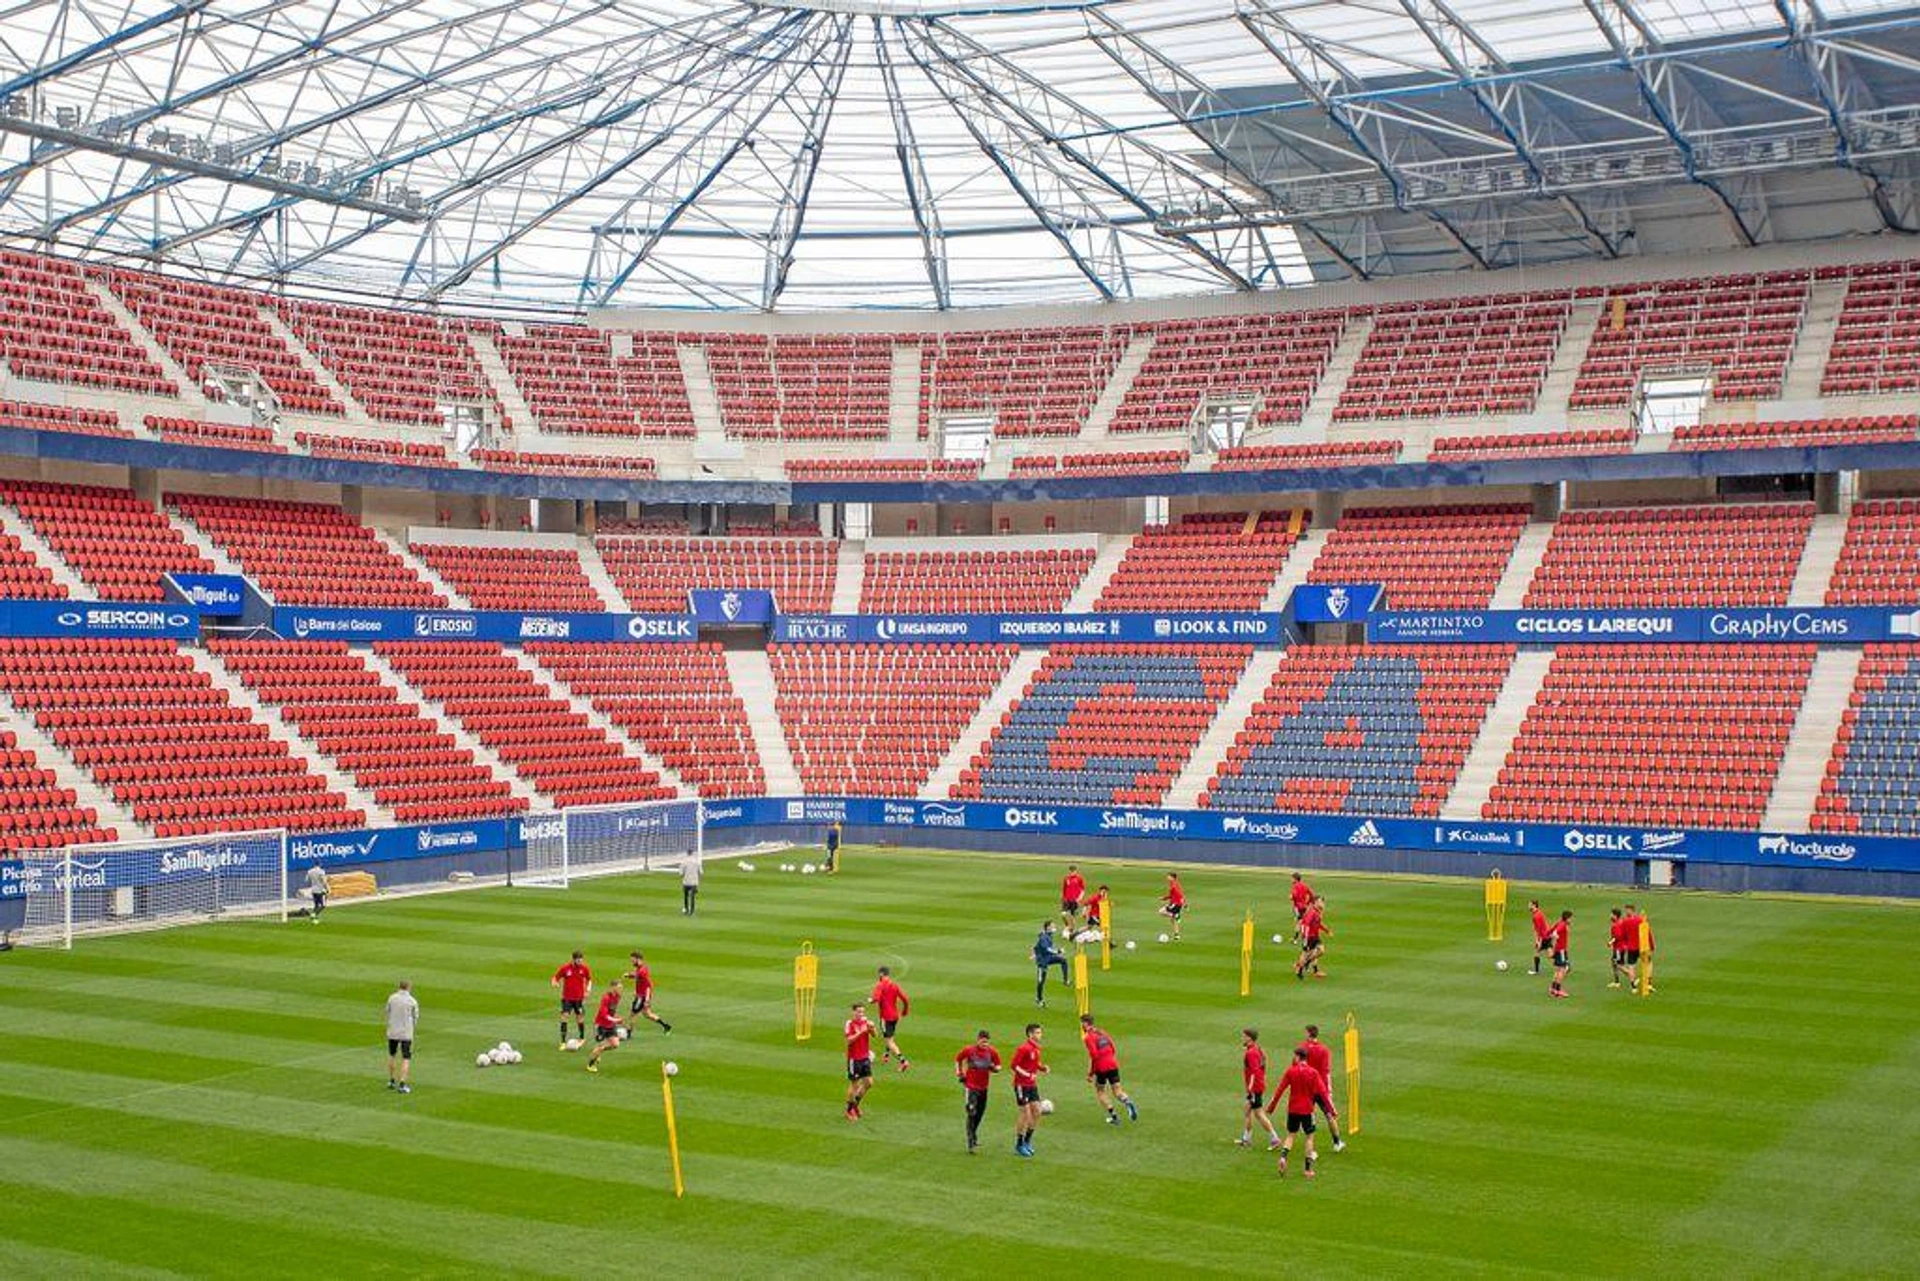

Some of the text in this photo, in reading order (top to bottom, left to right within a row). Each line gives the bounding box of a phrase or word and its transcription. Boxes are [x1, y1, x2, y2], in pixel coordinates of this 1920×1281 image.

[87, 611, 164, 625] SERCOIN
[308, 618, 335, 633] Barra
[350, 618, 382, 632] Goloso
[432, 618, 473, 632] EROSKI
[1399, 615, 1484, 629] MARTINTXO
[787, 623, 847, 639] IRACHE
[1000, 619, 1106, 635] IZQUIERDO IBAÑEZ
[1173, 619, 1268, 634] LOOK & FIND
[1515, 618, 1673, 635] CICLOS LAREQUI
[1348, 835, 1386, 846] adidas
